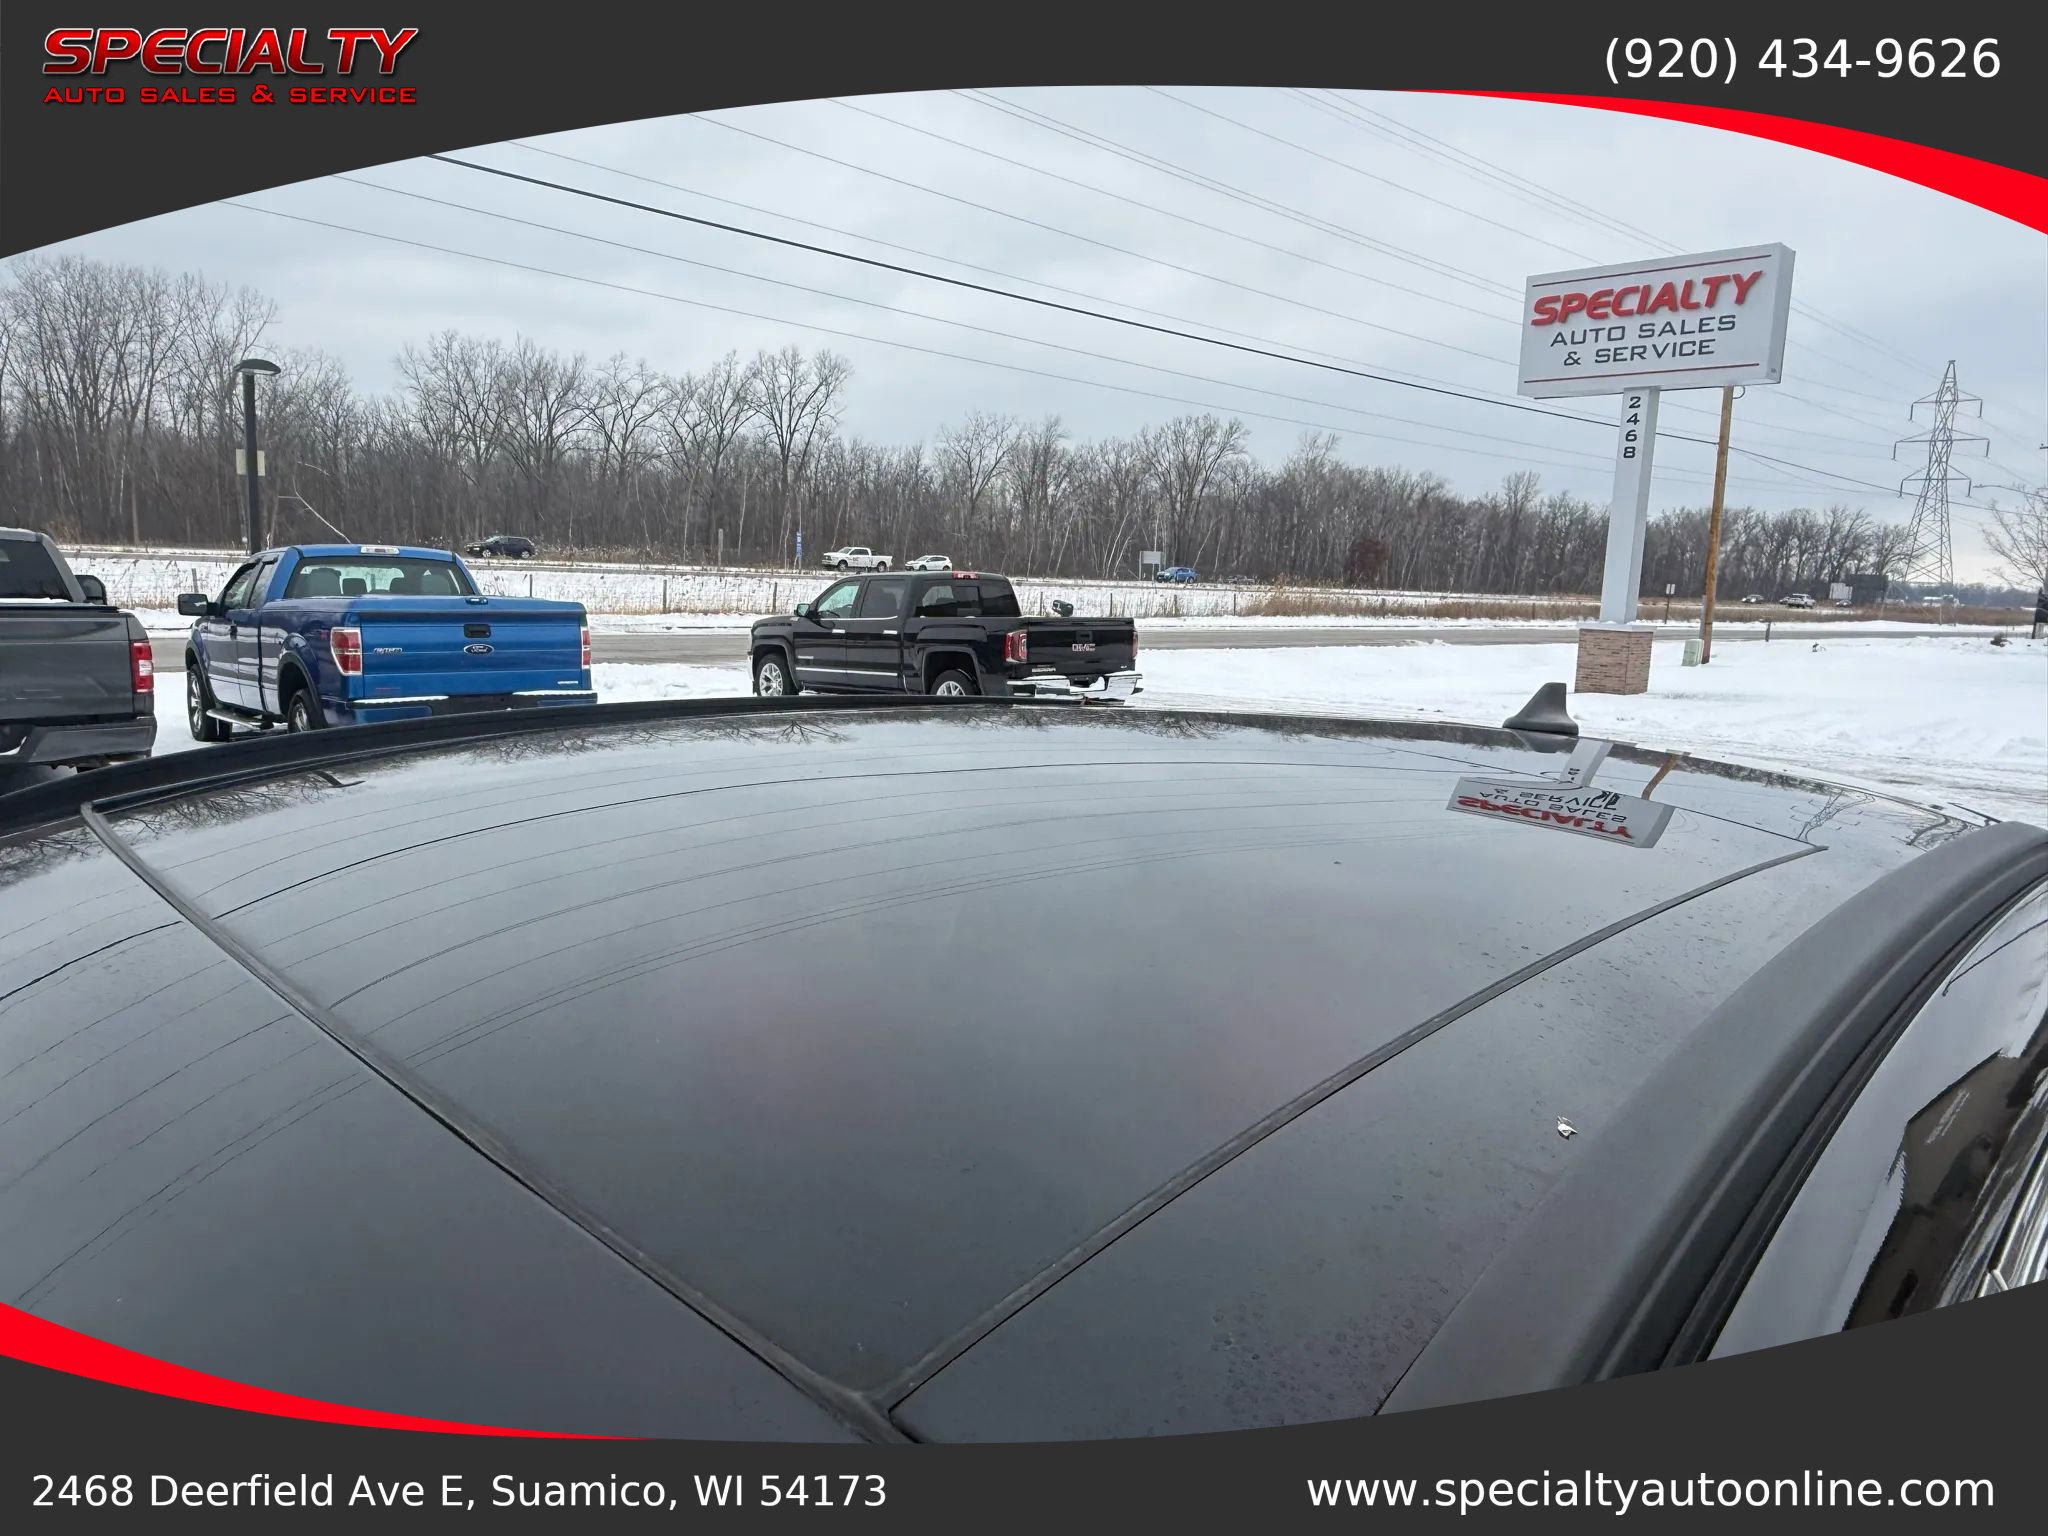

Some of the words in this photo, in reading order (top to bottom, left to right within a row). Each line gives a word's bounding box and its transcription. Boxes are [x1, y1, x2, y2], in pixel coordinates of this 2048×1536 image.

[1531, 270, 1764, 326] SPECIALTY
[1550, 325, 1626, 347] AUTO
[1638, 314, 1737, 339] SALES
[1563, 351, 1582, 366] &
[1594, 338, 1716, 364] SERVICE
